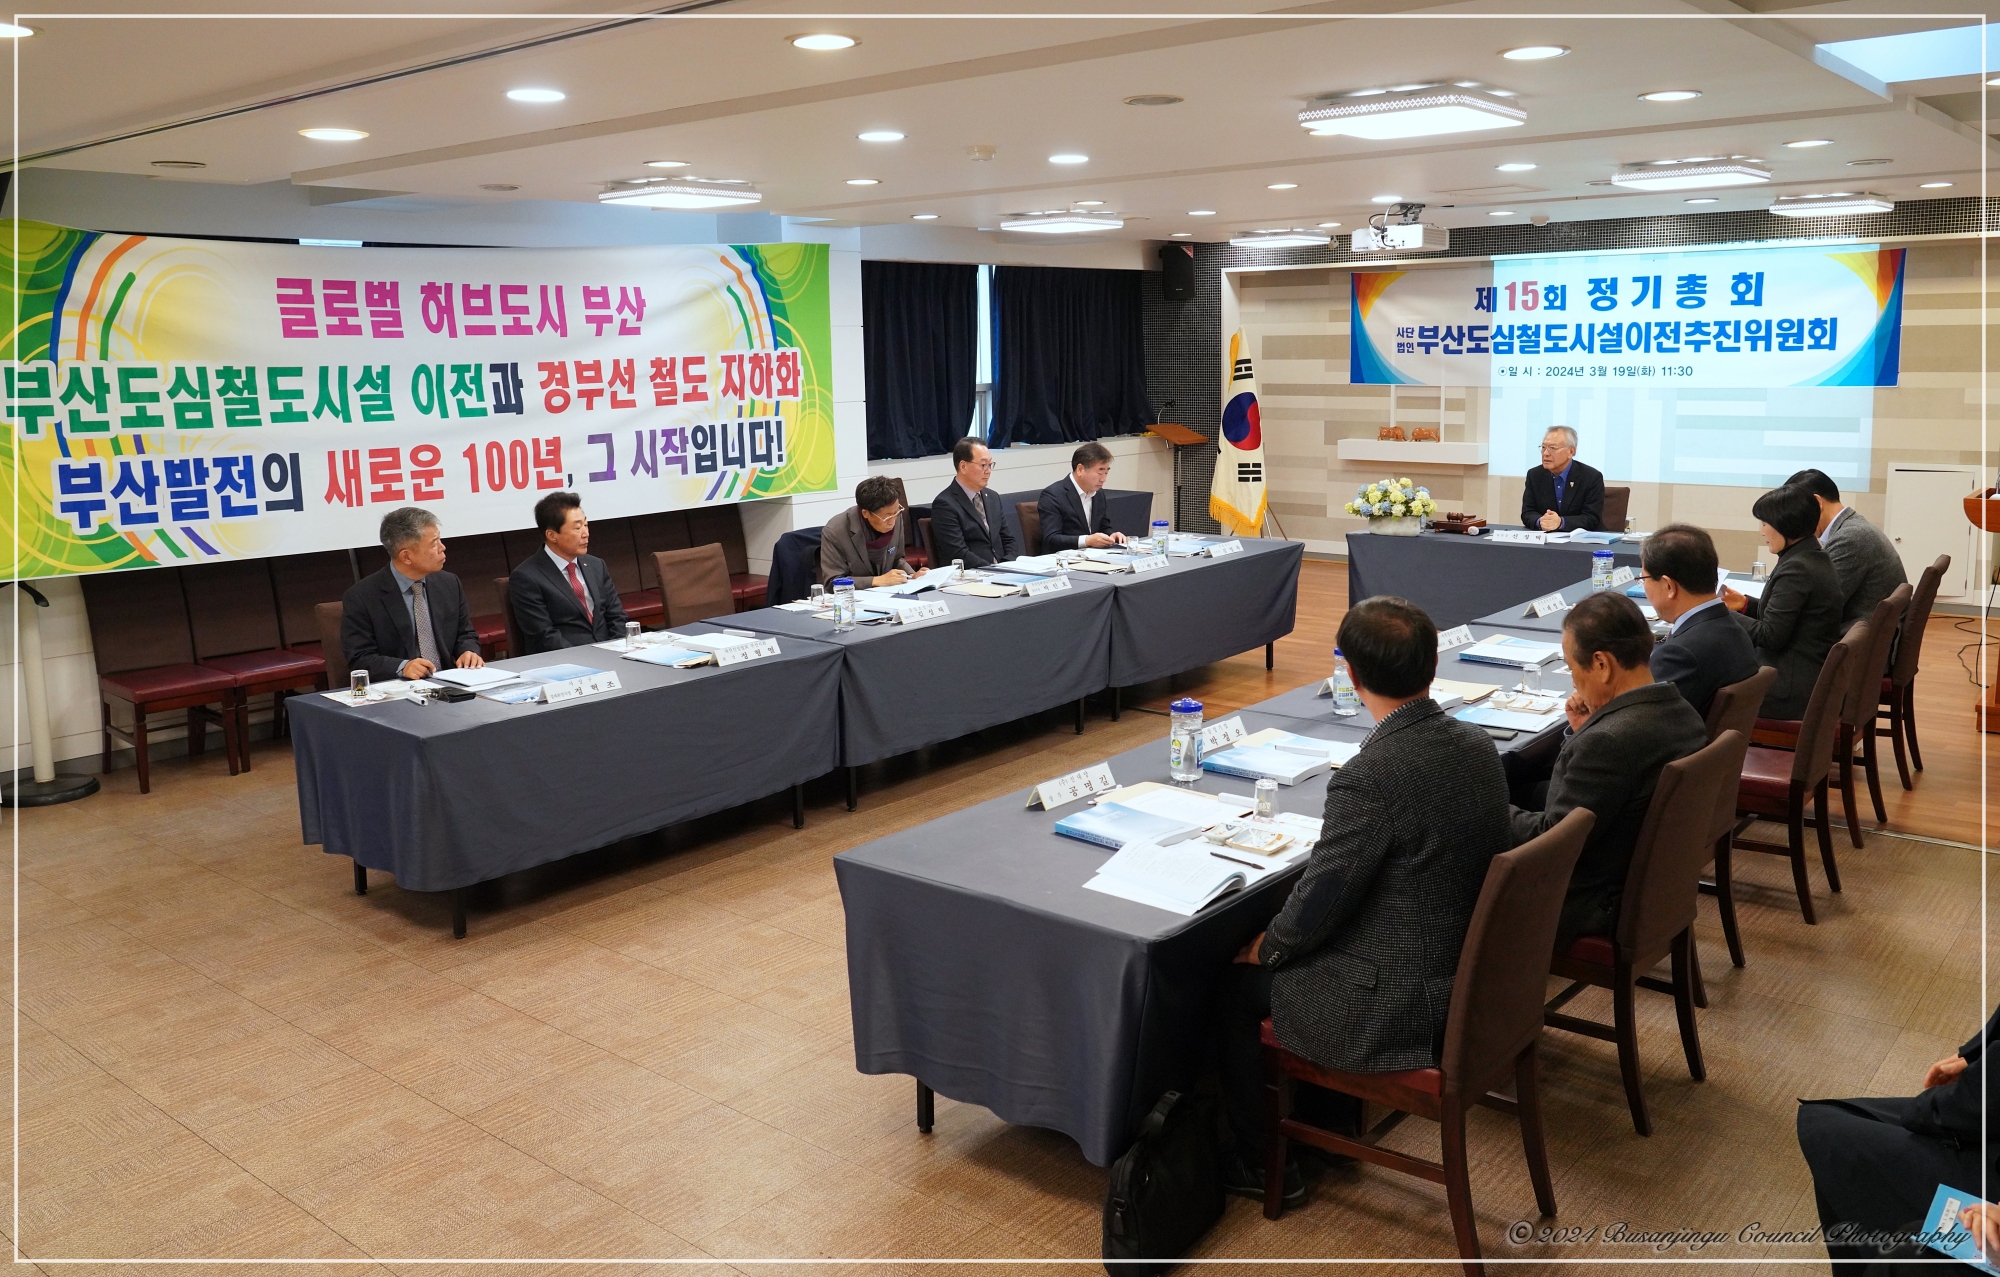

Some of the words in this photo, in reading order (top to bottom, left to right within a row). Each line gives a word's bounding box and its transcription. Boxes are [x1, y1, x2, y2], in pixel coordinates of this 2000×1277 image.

[276, 277, 405, 339] 글로벌
[420, 281, 568, 338] 허브도시
[582, 285, 647, 337] 부산
[1396, 326, 1415, 339] 사단
[1396, 341, 1415, 354] 법인
[1416, 317, 1839, 355] 부산도심철도시설이전추진위원회
[1545, 366, 1584, 377] 2024년
[1589, 366, 1607, 377] 3월
[1612, 366, 1656, 377] 19일(화)
[1661, 366, 1693, 377] 11:30
[4, 364, 396, 435] 부산도심철도시설
[411, 362, 524, 419] 이전과
[537, 357, 637, 414] 경부선
[649, 356, 709, 407] 철도
[720, 351, 801, 401] 지하화
[58, 452, 304, 529] 부산발전의
[324, 443, 445, 508] 새로운
[462, 436, 574, 492] 100년,
[587, 432, 617, 483] 그
[630, 419, 785, 480] 시작입니다!
